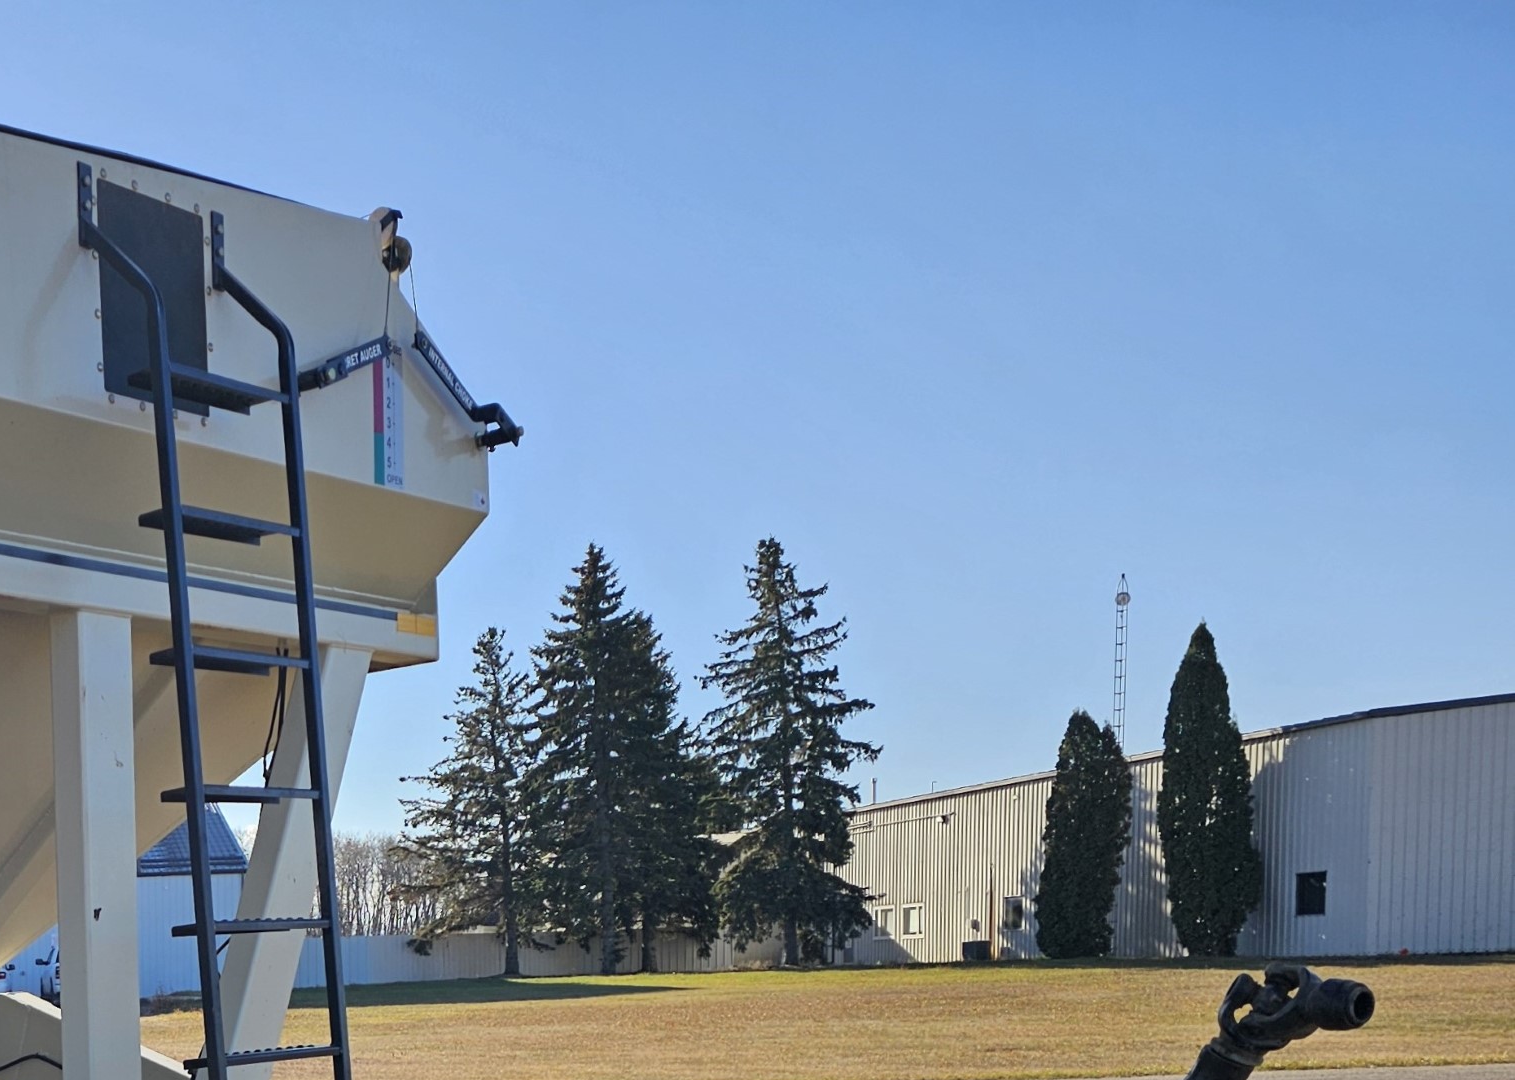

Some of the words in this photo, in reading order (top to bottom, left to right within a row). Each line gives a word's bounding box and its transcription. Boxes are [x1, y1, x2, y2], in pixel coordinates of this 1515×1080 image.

[344, 351, 360, 369] RET
[360, 344, 383, 363] AUGER
[428, 346, 454, 388] INTERNAL
[454, 381, 474, 411] CHOKE
[386, 474, 403, 486] OPEN
